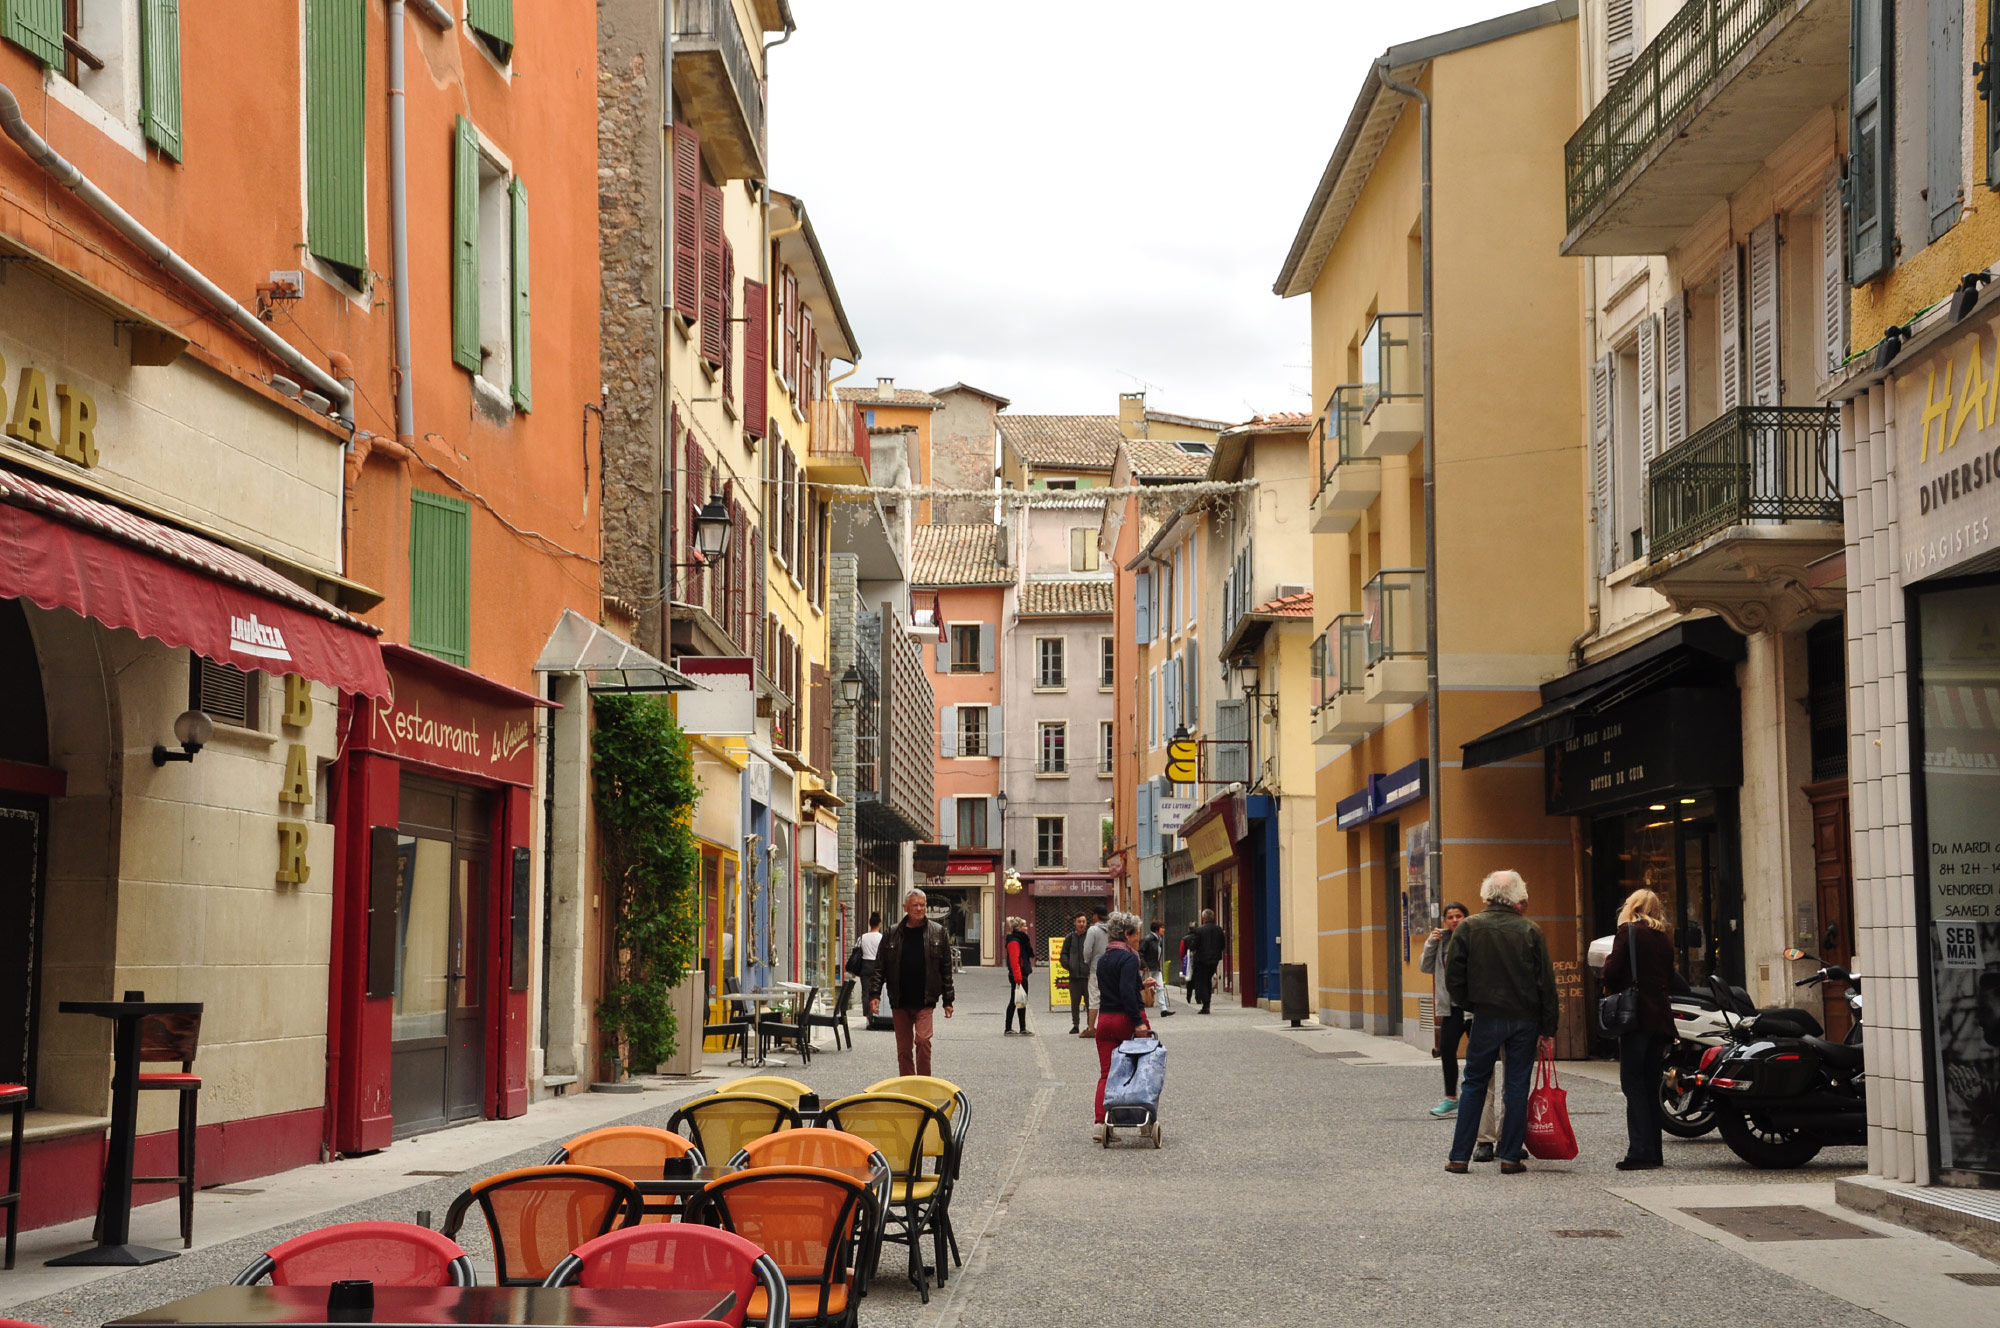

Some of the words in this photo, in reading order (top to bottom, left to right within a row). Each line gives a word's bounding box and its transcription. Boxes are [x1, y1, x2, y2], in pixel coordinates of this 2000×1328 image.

[1905, 516, 1989, 574] VISAGISTES
[230, 612, 288, 650] LAVAZZA
[371, 669, 481, 757] Restaurant
[490, 730, 502, 764] Le
[502, 719, 529, 758] Casino
[276, 673, 313, 885] BAR
[1616, 770, 1625, 785] DE
[1629, 765, 1644, 781] CUIR
[1952, 842, 1990, 854] MARDI
[1939, 863, 1955, 875] 8H
[1069, 881, 1079, 891] de
[1938, 884, 1993, 896] VENDREDI
[1945, 904, 1989, 917] SAMEDI
[1946, 927, 1975, 944] SEB
[1946, 944, 1976, 959] MAN
[1555, 975, 1581, 984] ELON
[1570, 988, 1583, 997] DE
